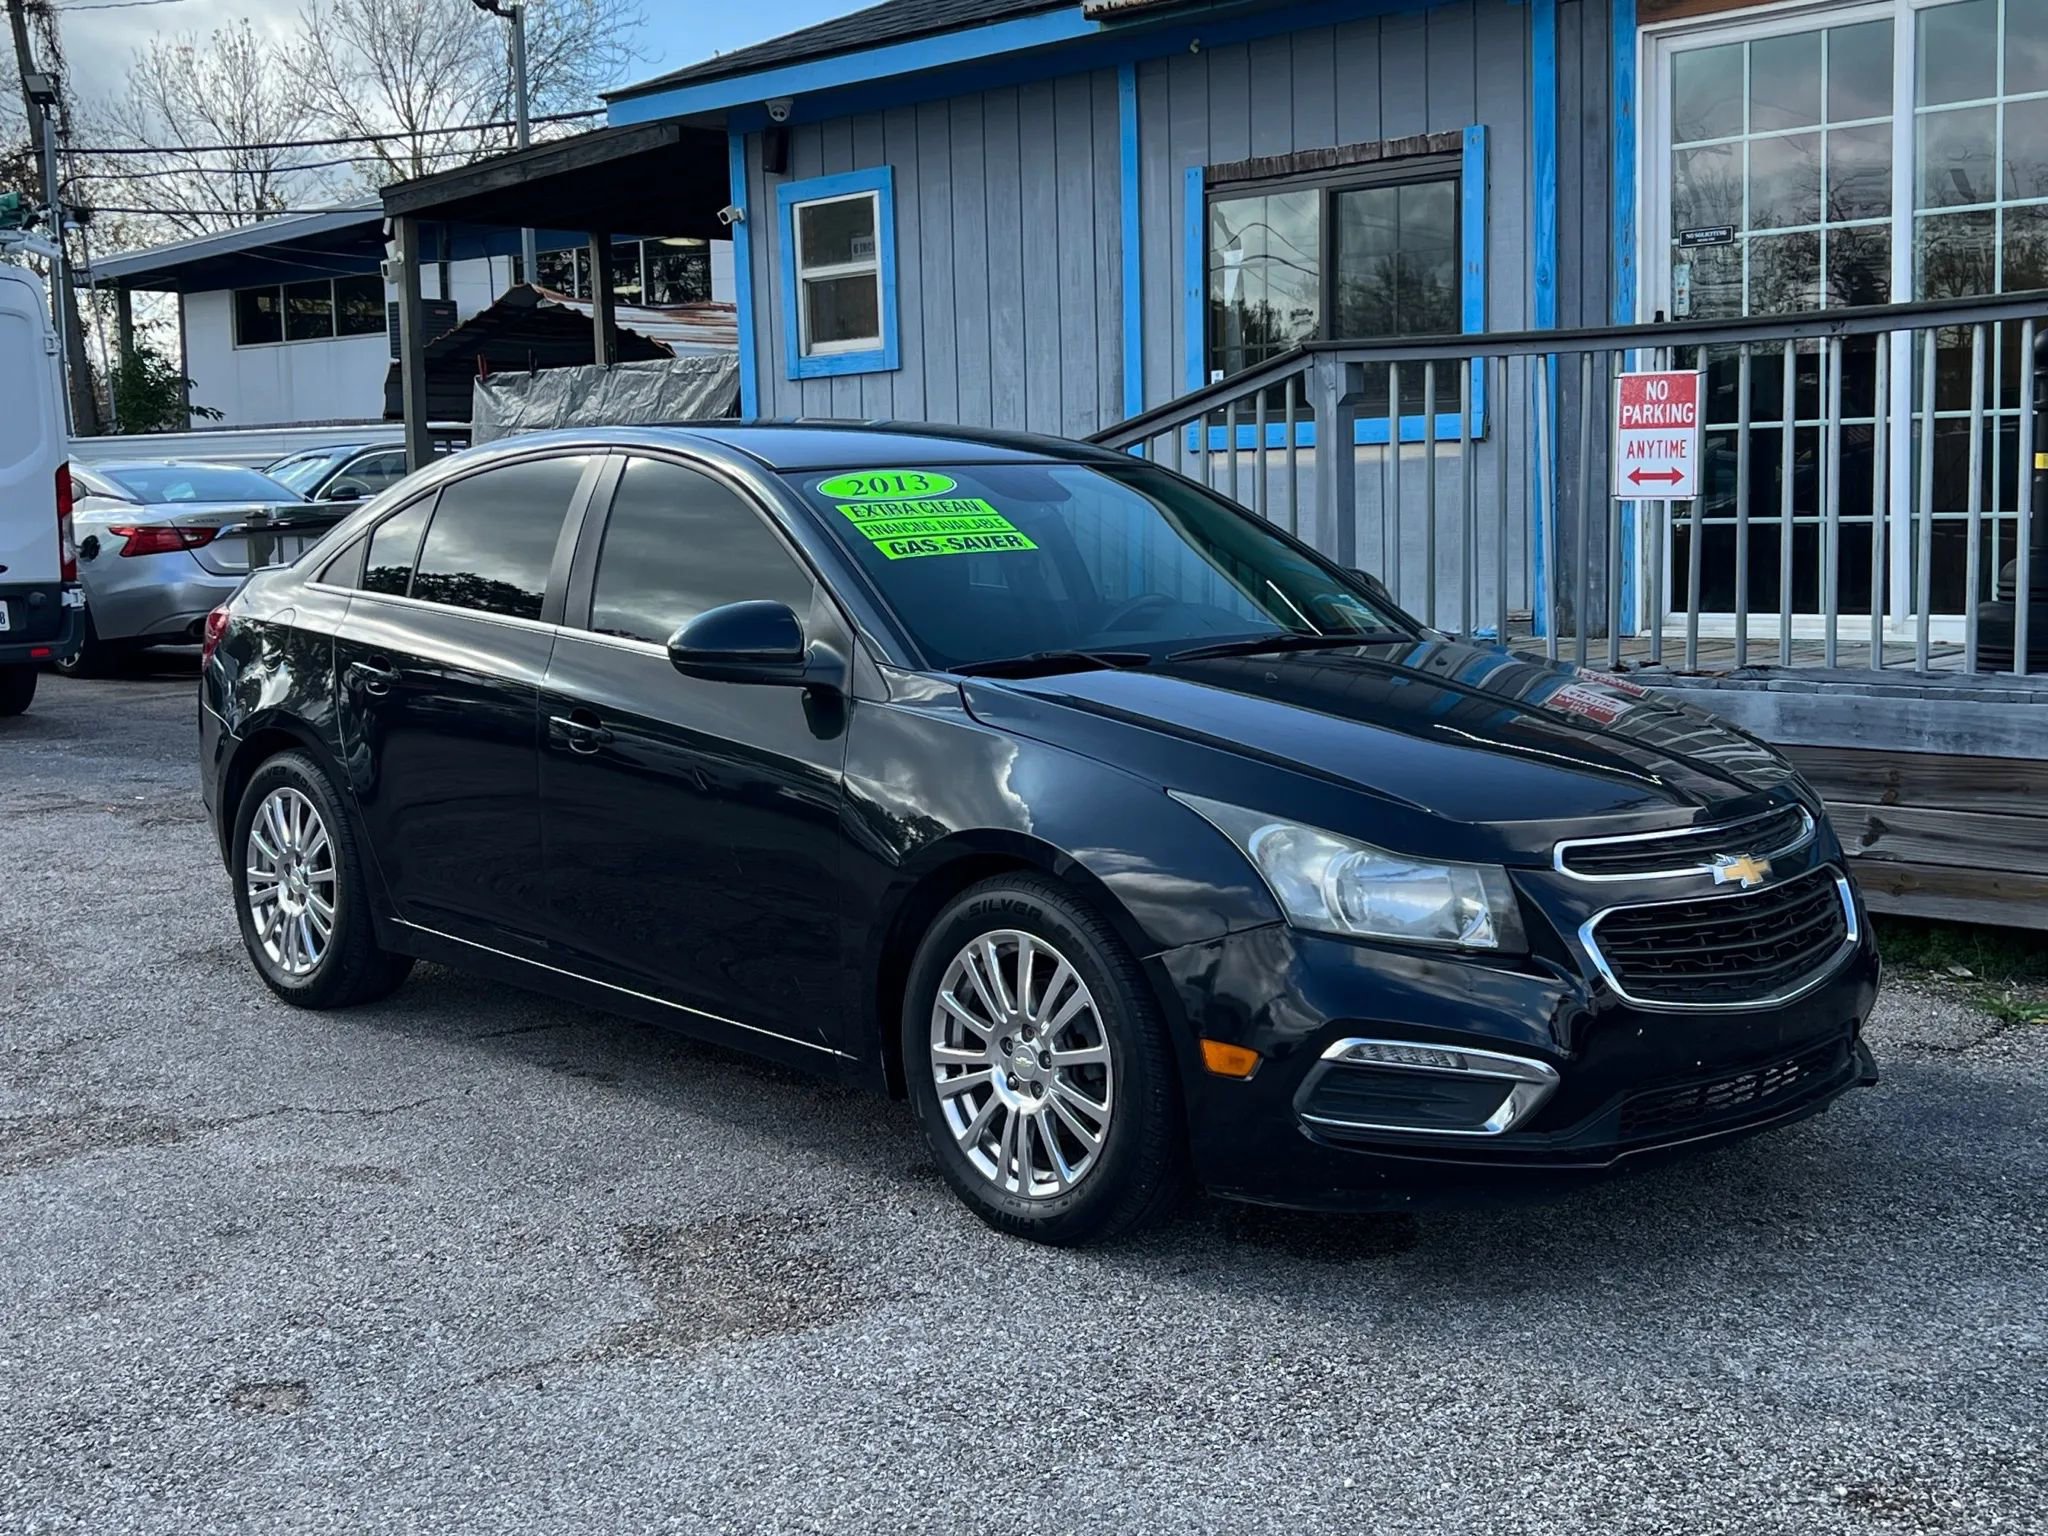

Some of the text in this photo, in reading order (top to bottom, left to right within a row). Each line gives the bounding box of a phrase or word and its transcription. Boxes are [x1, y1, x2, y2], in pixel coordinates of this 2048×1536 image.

[1646, 380, 1668, 401] NO
[1622, 402, 1694, 425] PARKING
[1626, 439, 1687, 459] ANYTIME
[846, 474, 930, 497] 2013
[850, 500, 981, 518] EXTRA CLEAN
[862, 517, 1009, 537] FINANCING AVAILABLE
[968, 898, 1044, 920] SILVER
